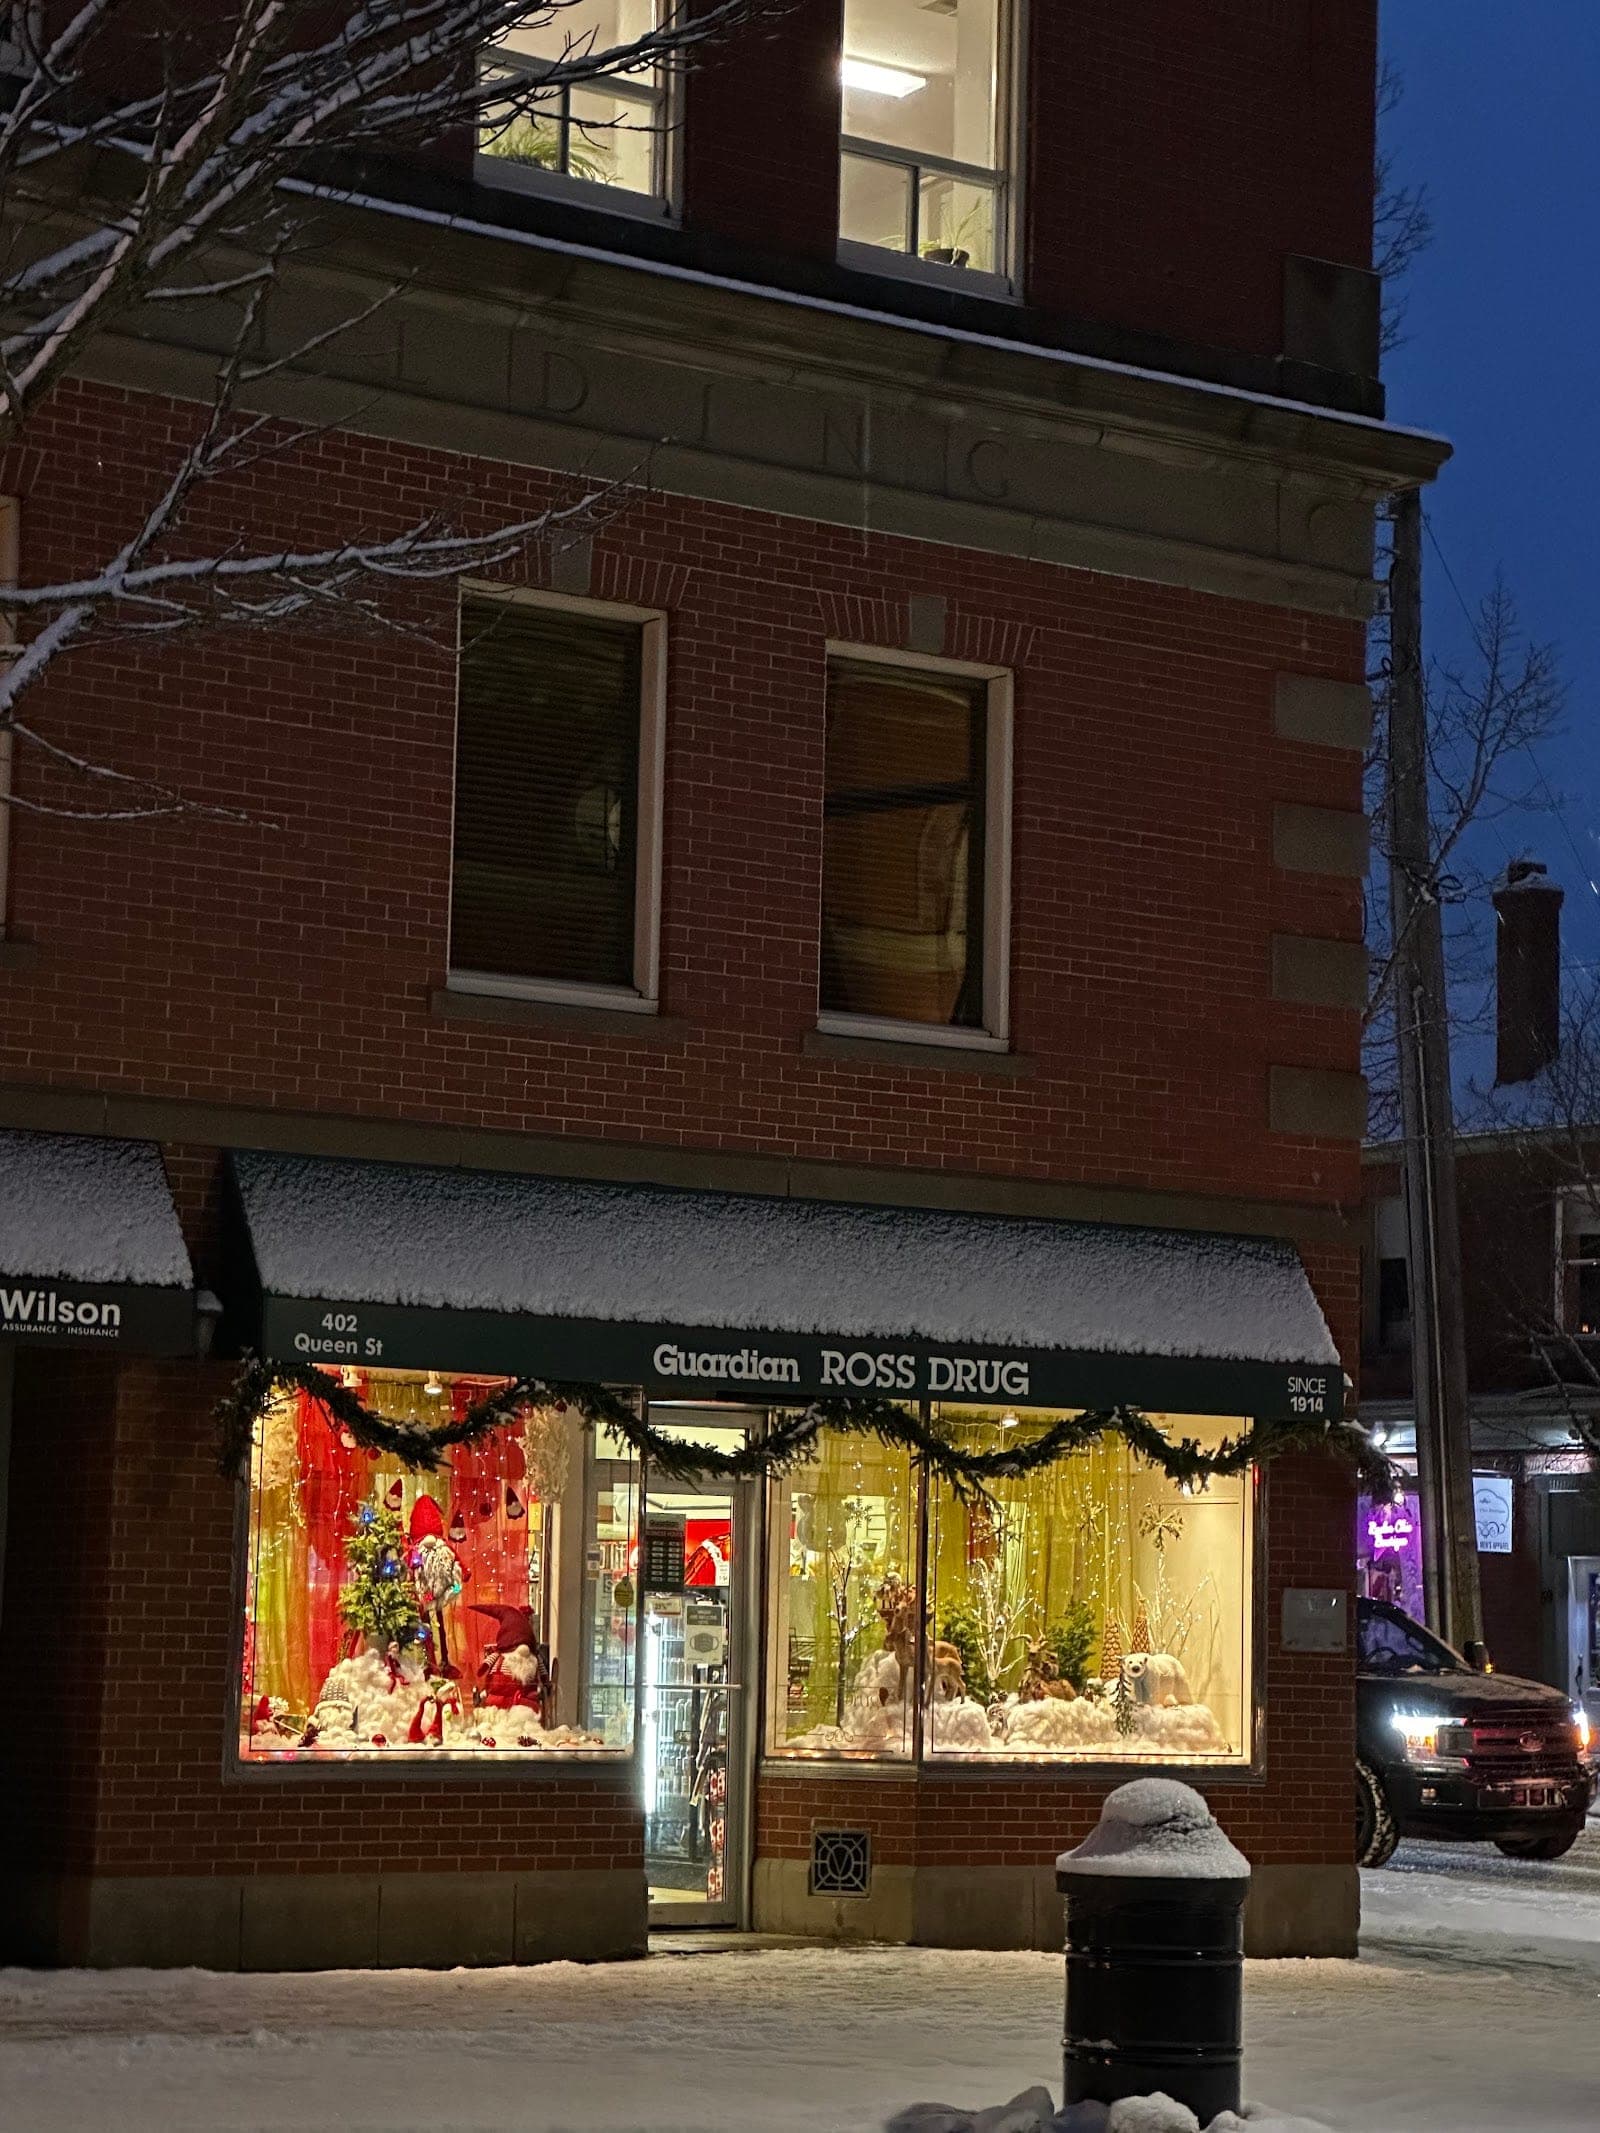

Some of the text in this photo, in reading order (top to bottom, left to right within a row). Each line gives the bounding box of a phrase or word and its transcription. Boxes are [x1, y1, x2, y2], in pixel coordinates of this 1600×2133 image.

[0, 1289, 121, 1326] Wilson
[2, 1321, 120, 1337] ASSURANCE INSURANCE
[321, 1313, 358, 1332] 402
[294, 1332, 384, 1356] Queen St
[653, 1343, 1030, 1396] Guardian ROSS DRUG
[1287, 1376, 1327, 1394] SINCE
[1290, 1395, 1324, 1413] 1914
